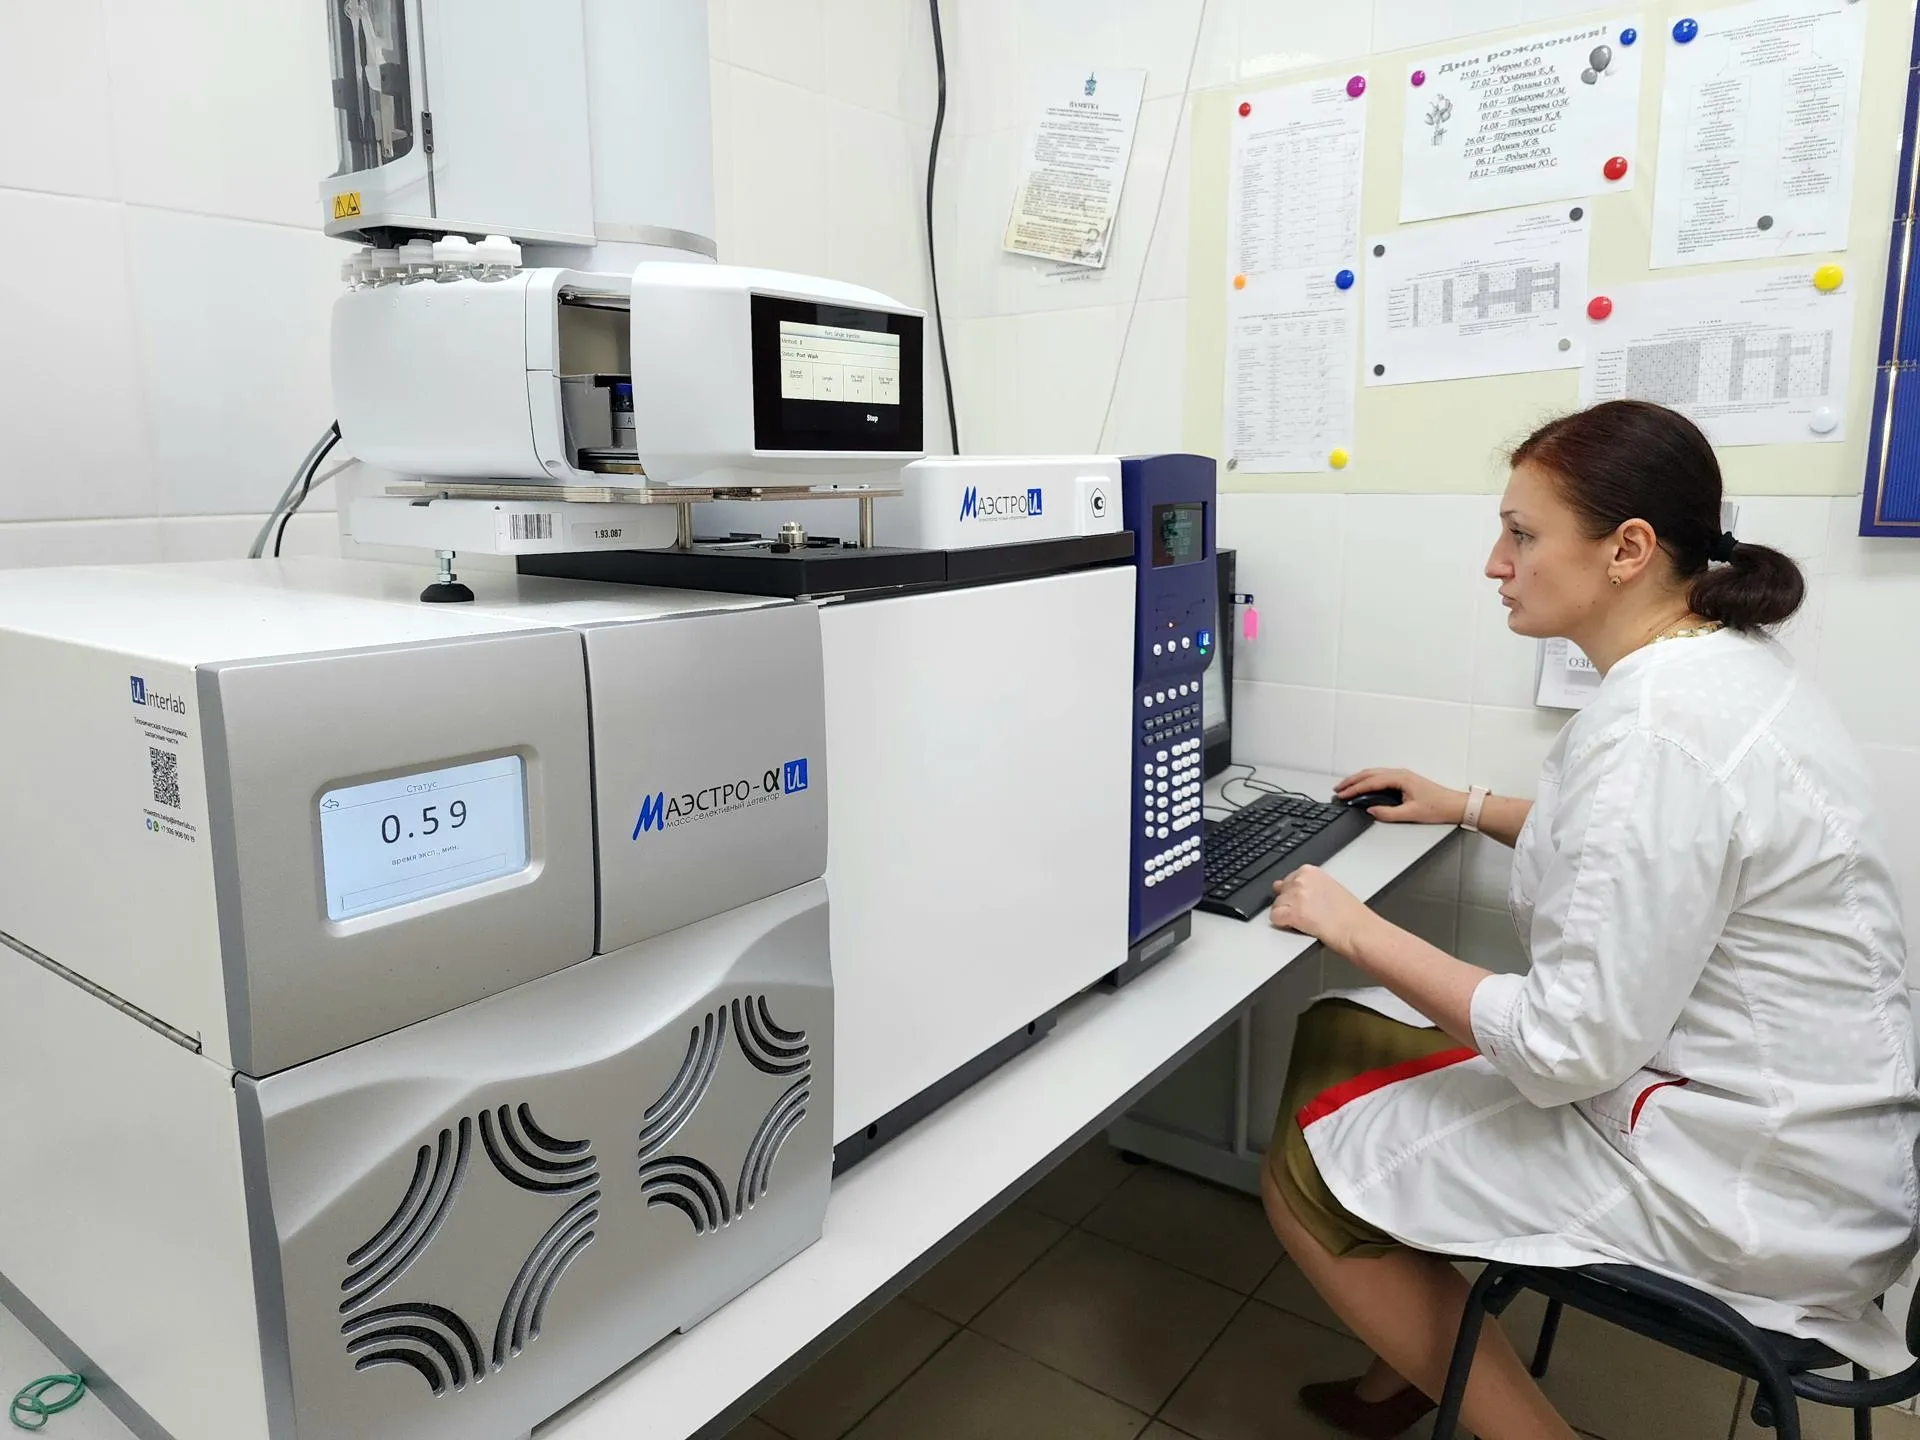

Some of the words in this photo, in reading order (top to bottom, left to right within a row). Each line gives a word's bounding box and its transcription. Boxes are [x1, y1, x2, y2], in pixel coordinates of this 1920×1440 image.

[1439, 58, 1479, 74] Дни
[866, 414, 878, 423] Stop
[960, 486, 1027, 522] МАЭСТРО
[146, 688, 185, 715] interlab
[406, 781, 438, 793] Статус
[666, 802, 745, 828] масс-селективный
[746, 792, 780, 808] детектор
[381, 800, 467, 843] 0.59
[391, 853, 417, 866] время
